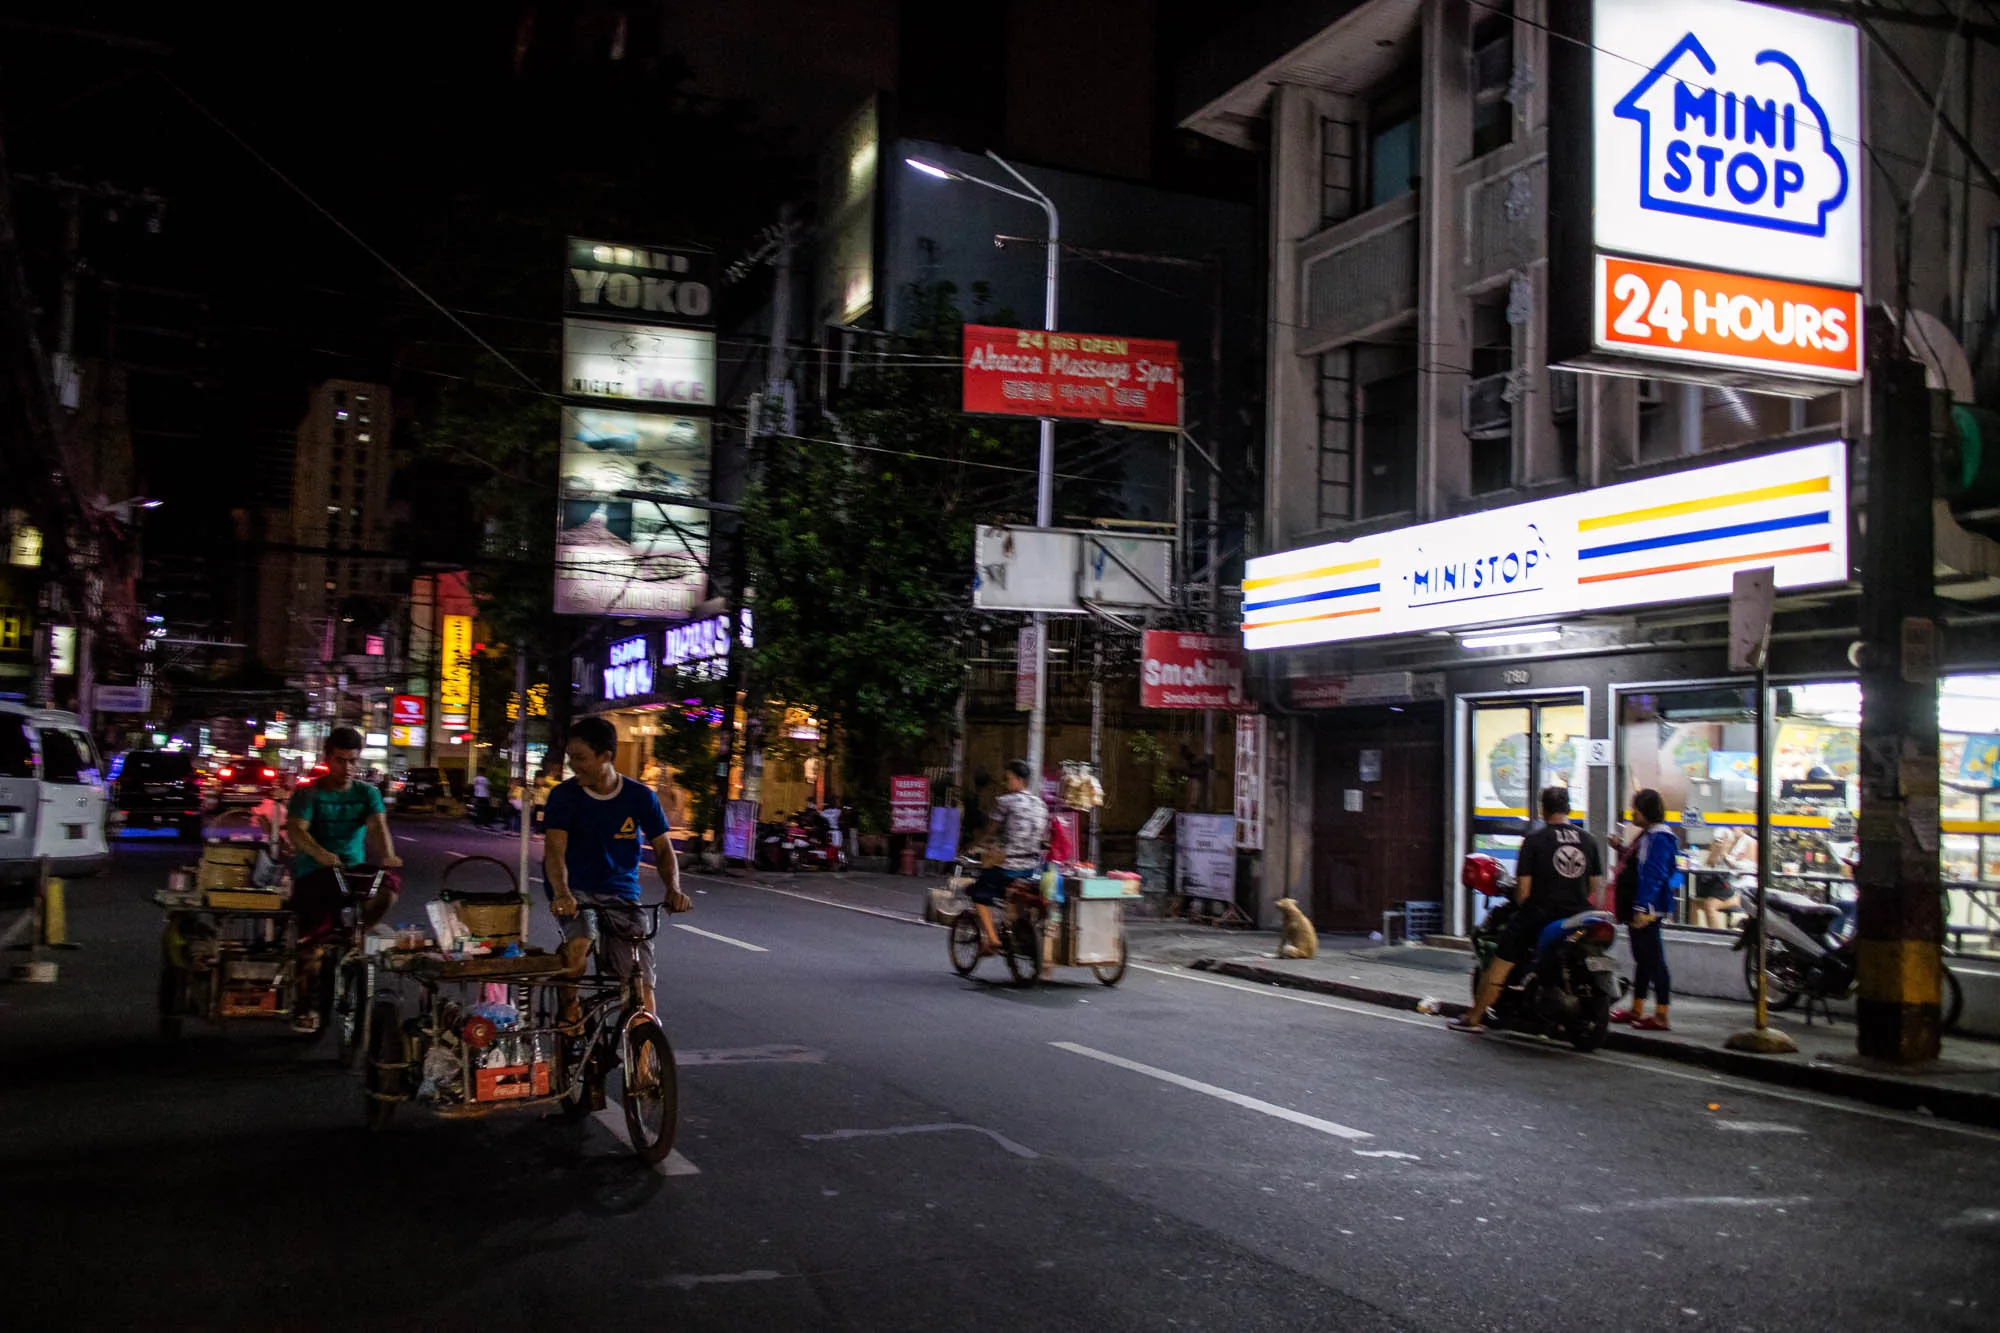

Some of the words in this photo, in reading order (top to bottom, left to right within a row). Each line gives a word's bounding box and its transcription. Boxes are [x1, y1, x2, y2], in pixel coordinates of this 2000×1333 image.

[1673, 80, 1795, 152] MINI
[1663, 139, 1805, 208] STOP
[570, 267, 711, 316] YOKO
[1613, 273, 1689, 342] 24
[1693, 288, 1850, 353] HOURS
[1016, 331, 1045, 350] 24
[1080, 337, 1129, 355] OPEN
[1049, 352, 1131, 389] Massage
[1135, 359, 1175, 391] Spa
